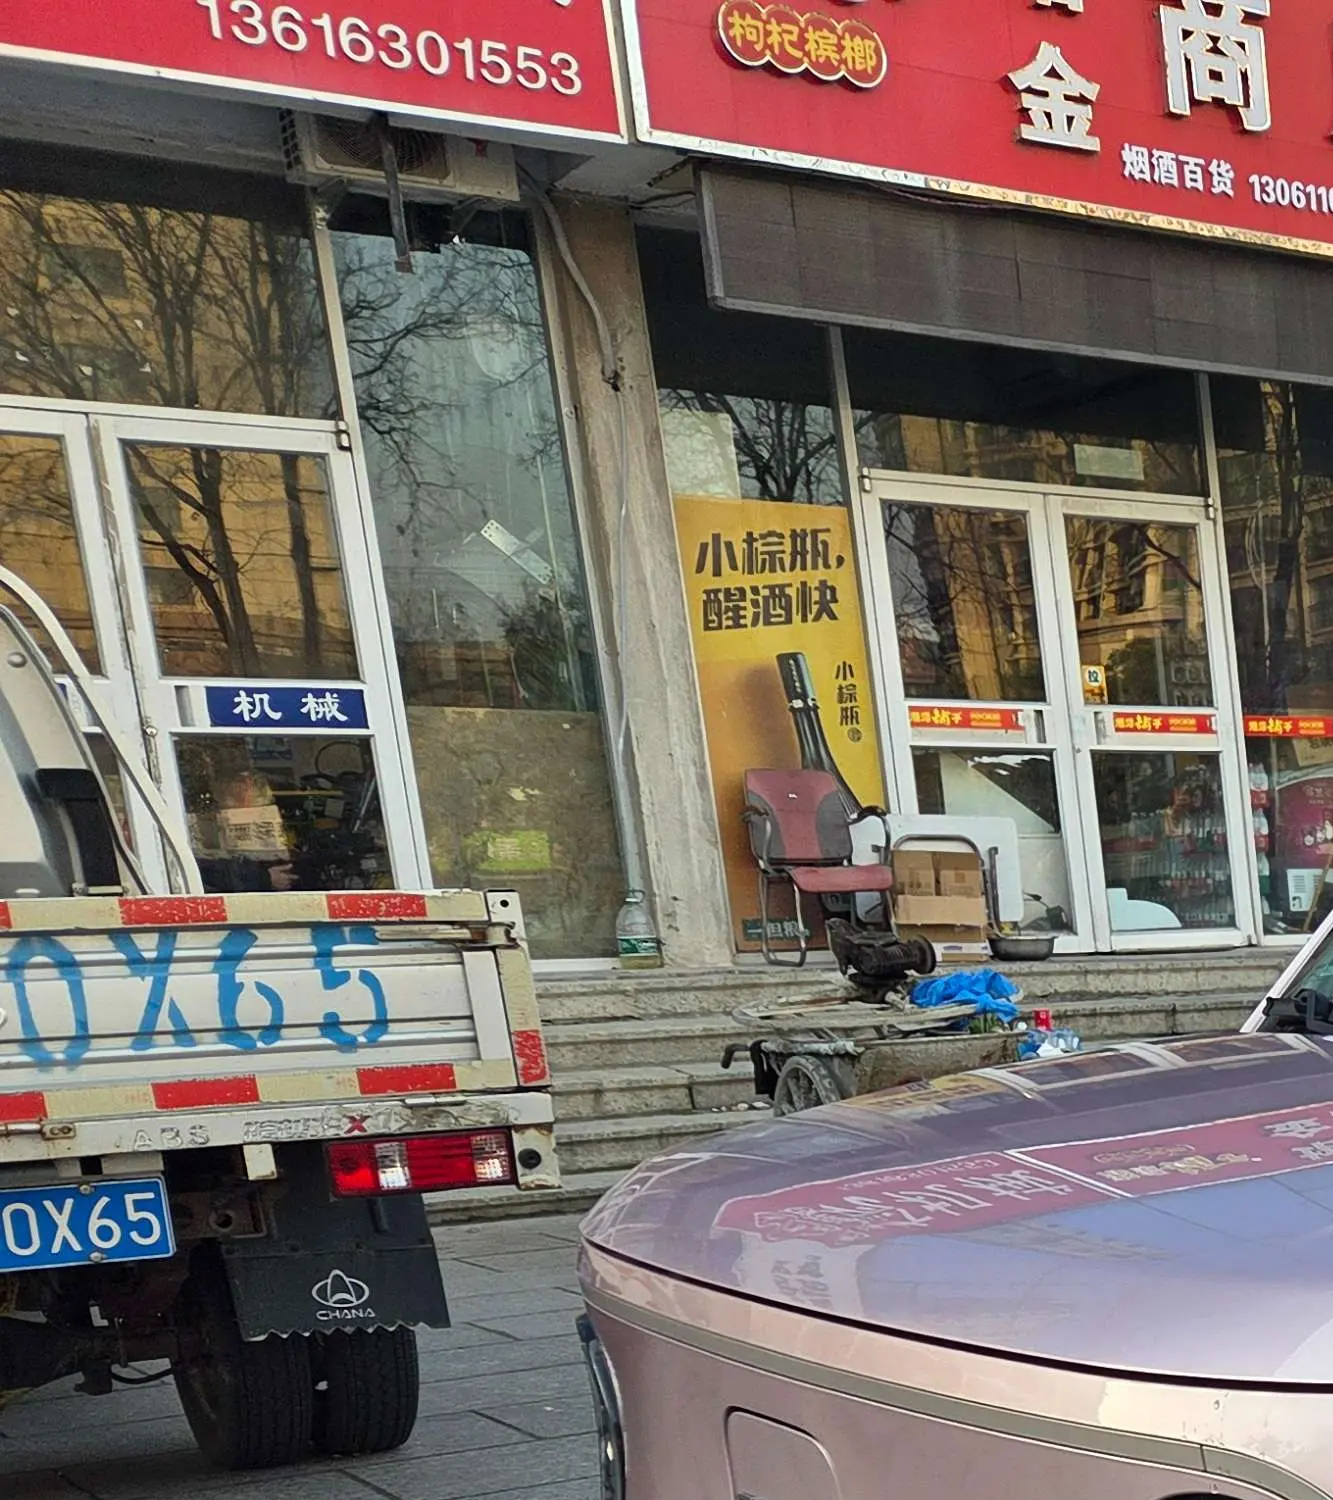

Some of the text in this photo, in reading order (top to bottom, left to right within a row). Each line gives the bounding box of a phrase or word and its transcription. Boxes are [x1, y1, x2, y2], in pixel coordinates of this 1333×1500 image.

[196, 0, 582, 95] 13616301553
[728, 9, 877, 74] 枸杞槟榔
[1008, 41, 1101, 152] 金
[1121, 143, 1235, 197] 烟酒百货
[702, 579, 840, 632] 醒酒快
[233, 689, 348, 722] 机械
[835, 660, 861, 727] 小棕瓶
[316, 1308, 376, 1320] CHANA
